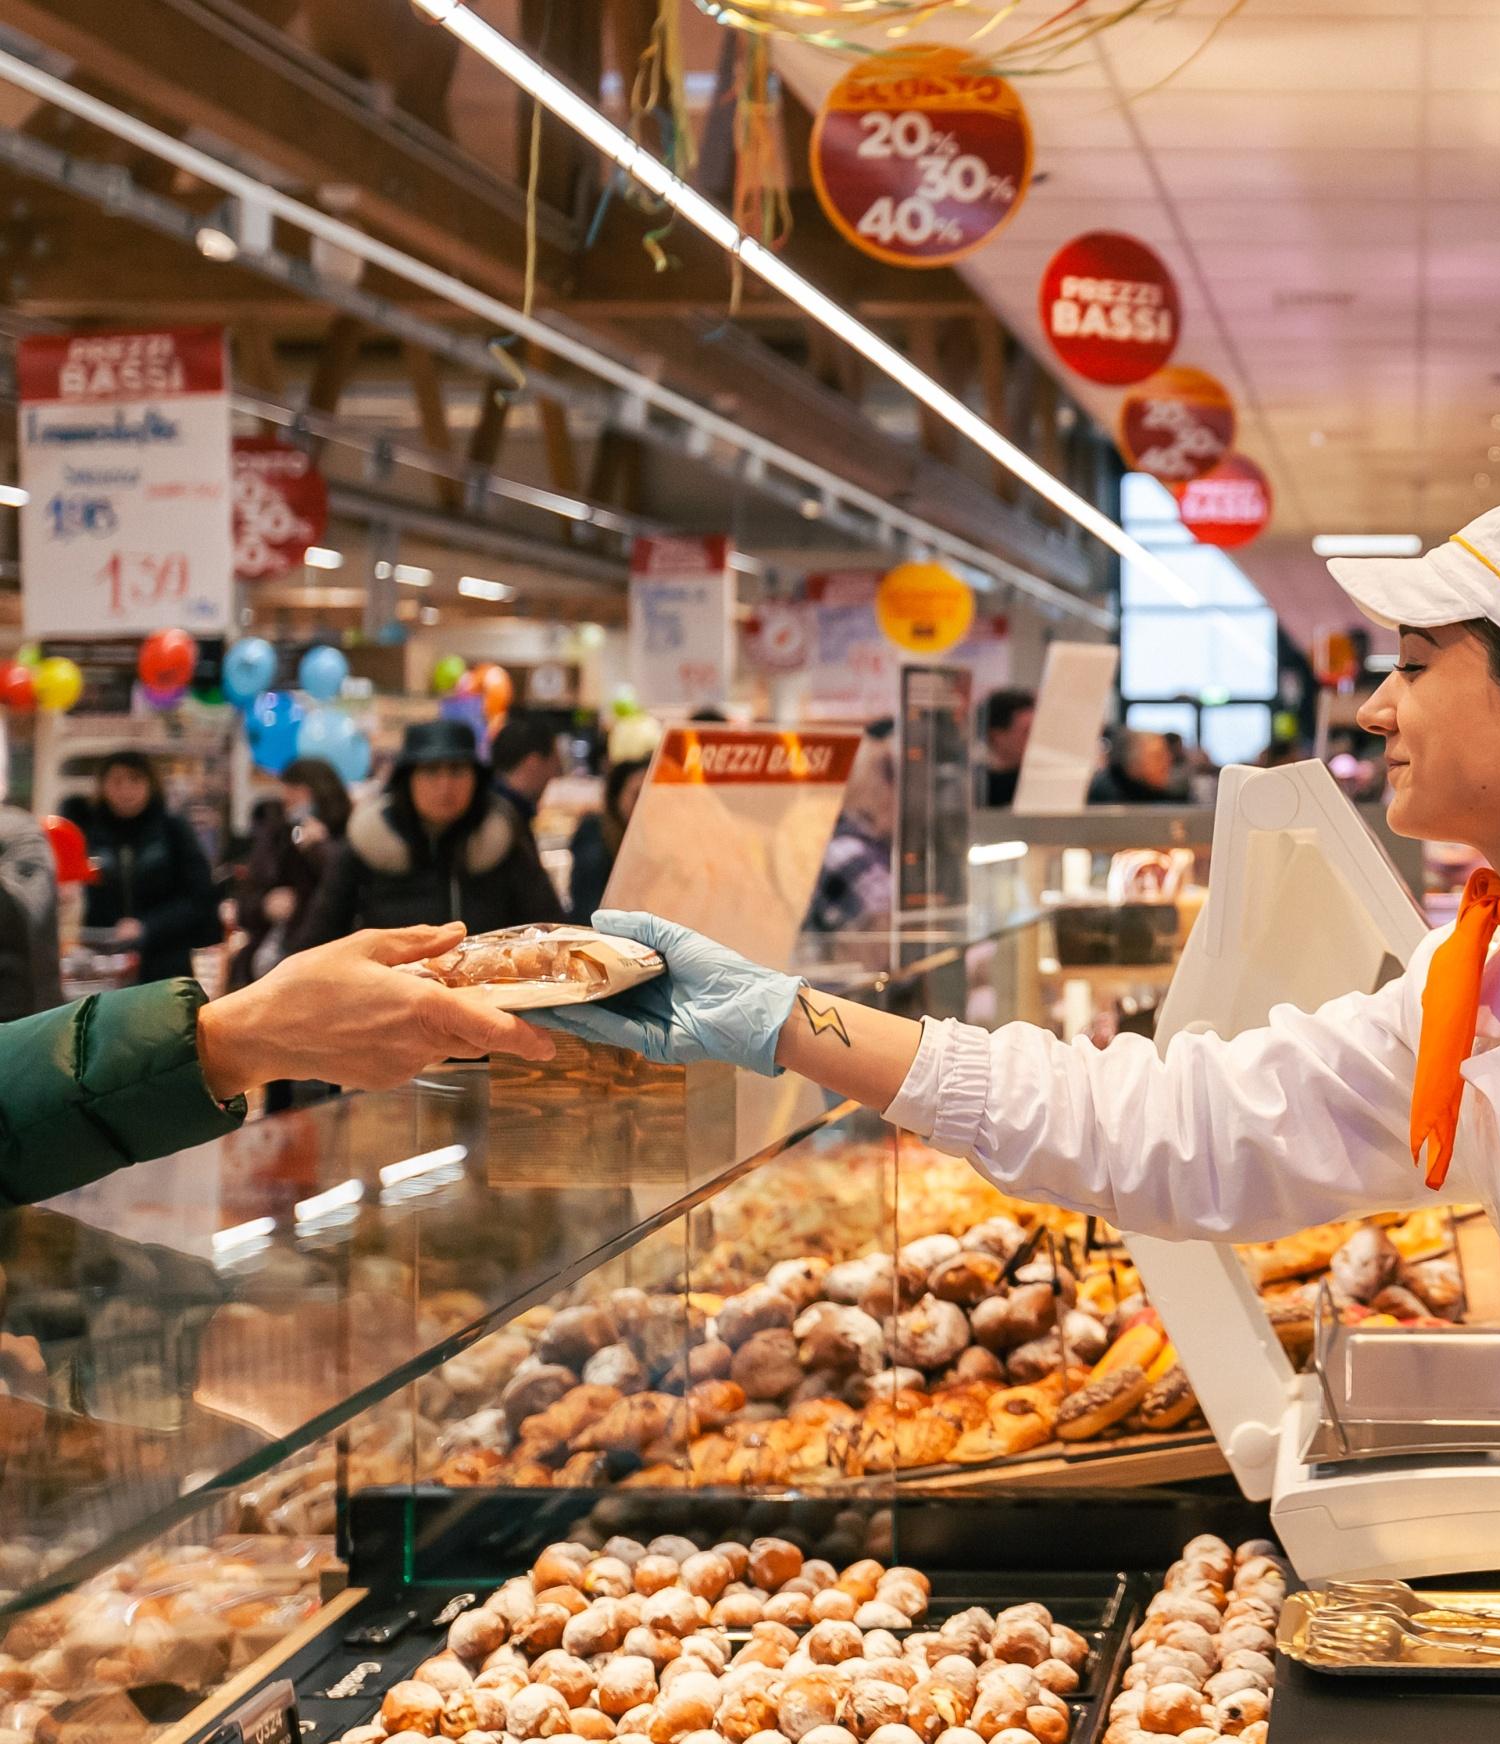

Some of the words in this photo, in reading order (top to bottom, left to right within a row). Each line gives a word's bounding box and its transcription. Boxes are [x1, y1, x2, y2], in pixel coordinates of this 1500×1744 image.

[857, 110, 959, 160] 20%
[914, 154, 1018, 203] 30%
[856, 195, 963, 245] 40%
[1061, 275, 1164, 306] PREZZI
[1051, 298, 1173, 345] BASSI
[68, 334, 175, 361] PREZZI
[58, 358, 185, 397] BASSI
[683, 743, 766, 775] PREZZI
[766, 744, 833, 776] BASSI
